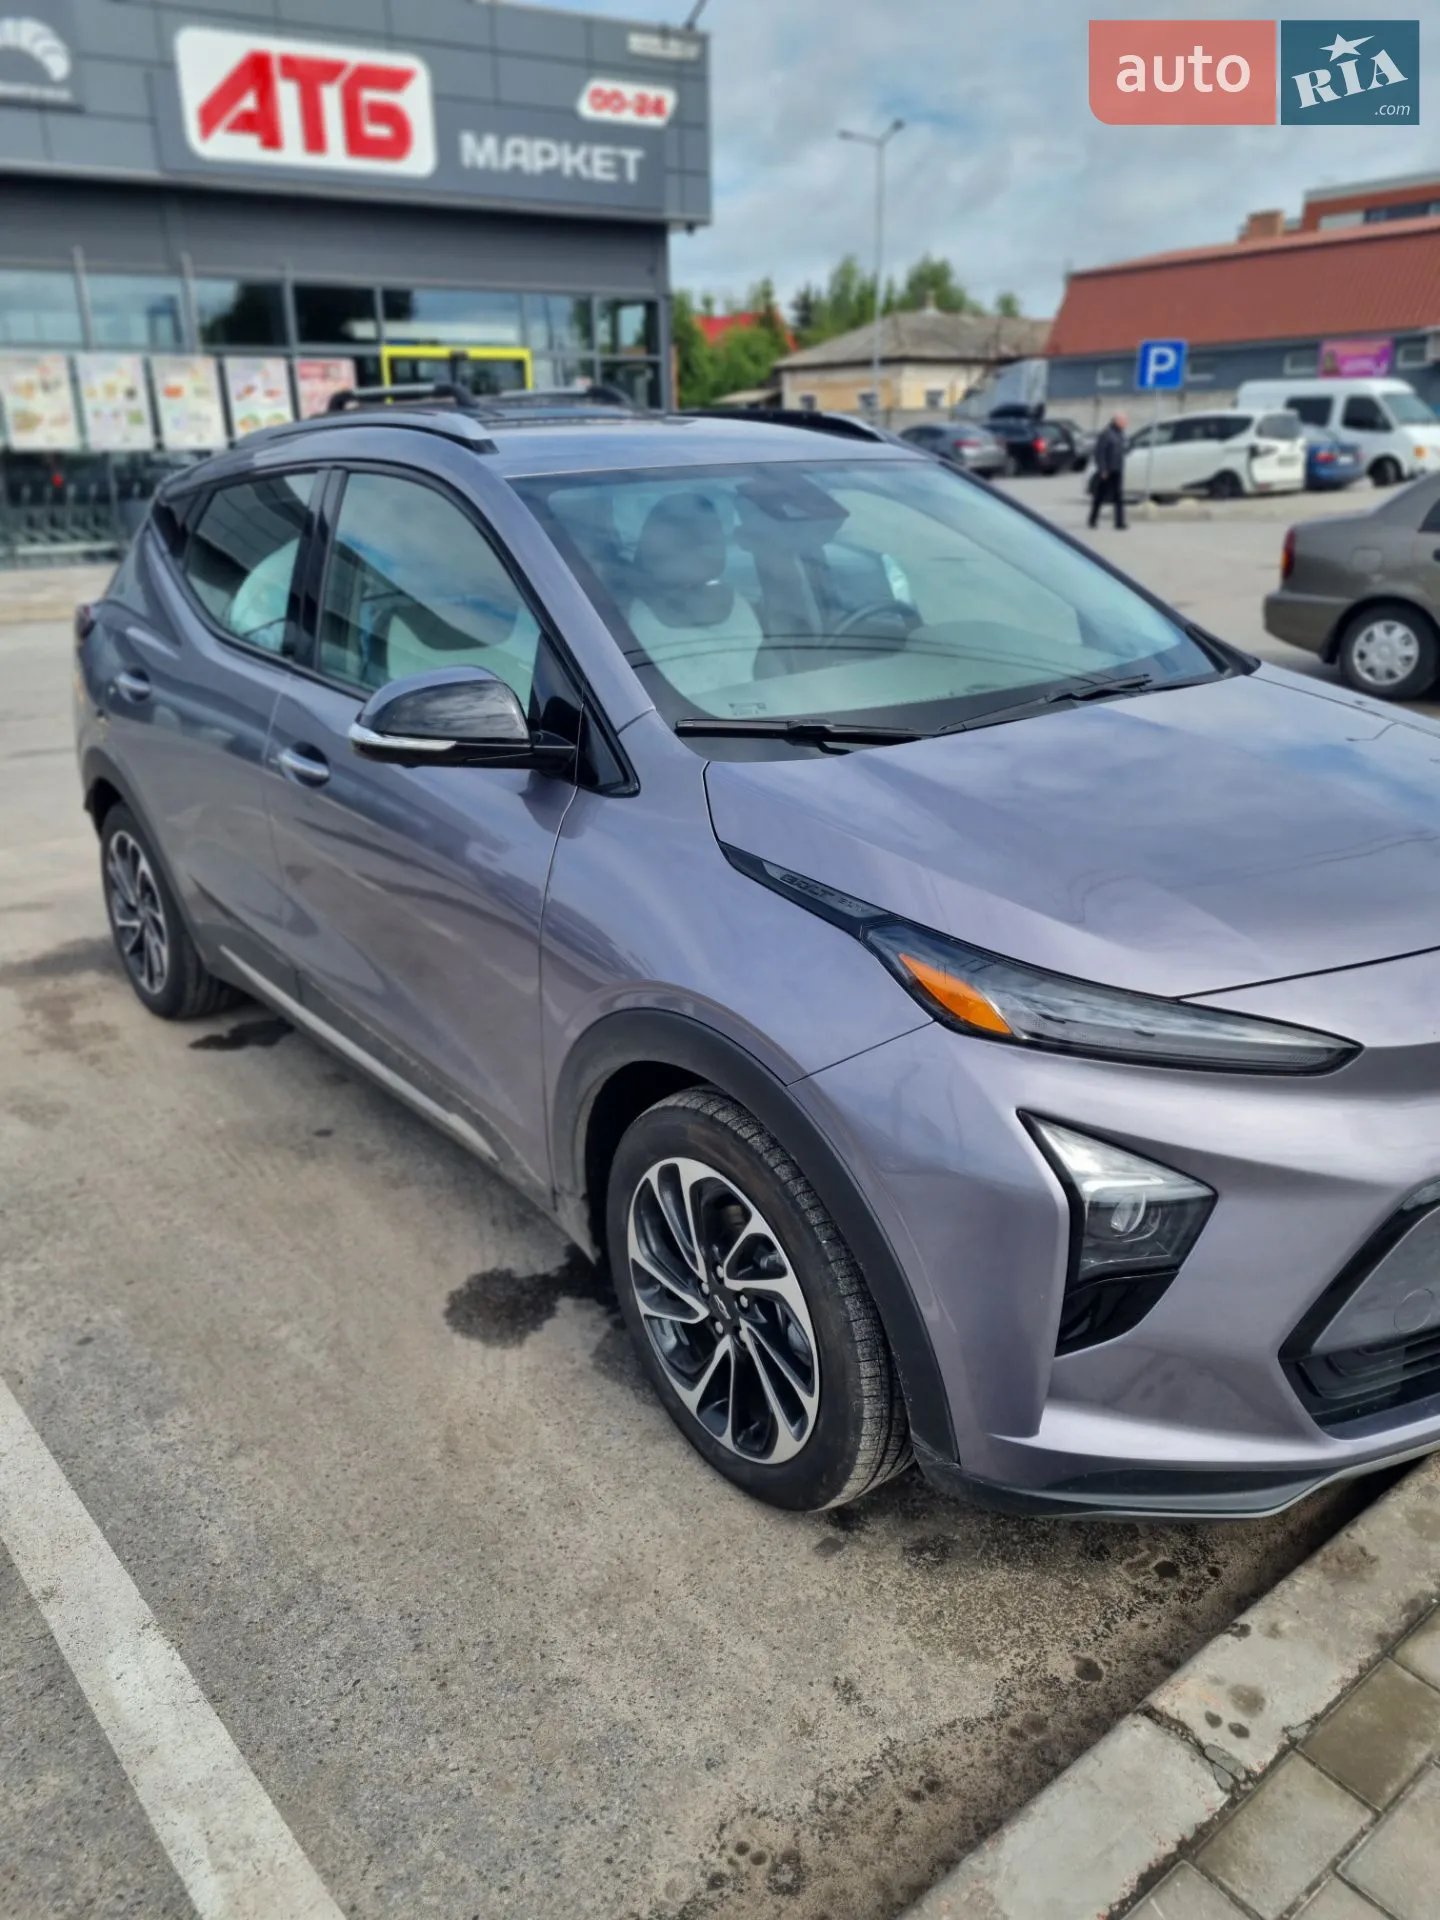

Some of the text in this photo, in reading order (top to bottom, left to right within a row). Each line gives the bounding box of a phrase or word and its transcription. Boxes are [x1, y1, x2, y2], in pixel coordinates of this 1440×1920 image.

[198, 50, 417, 162] АТБ
[460, 131, 644, 183] МАРКЕТ
[1146, 346, 1177, 385] P
